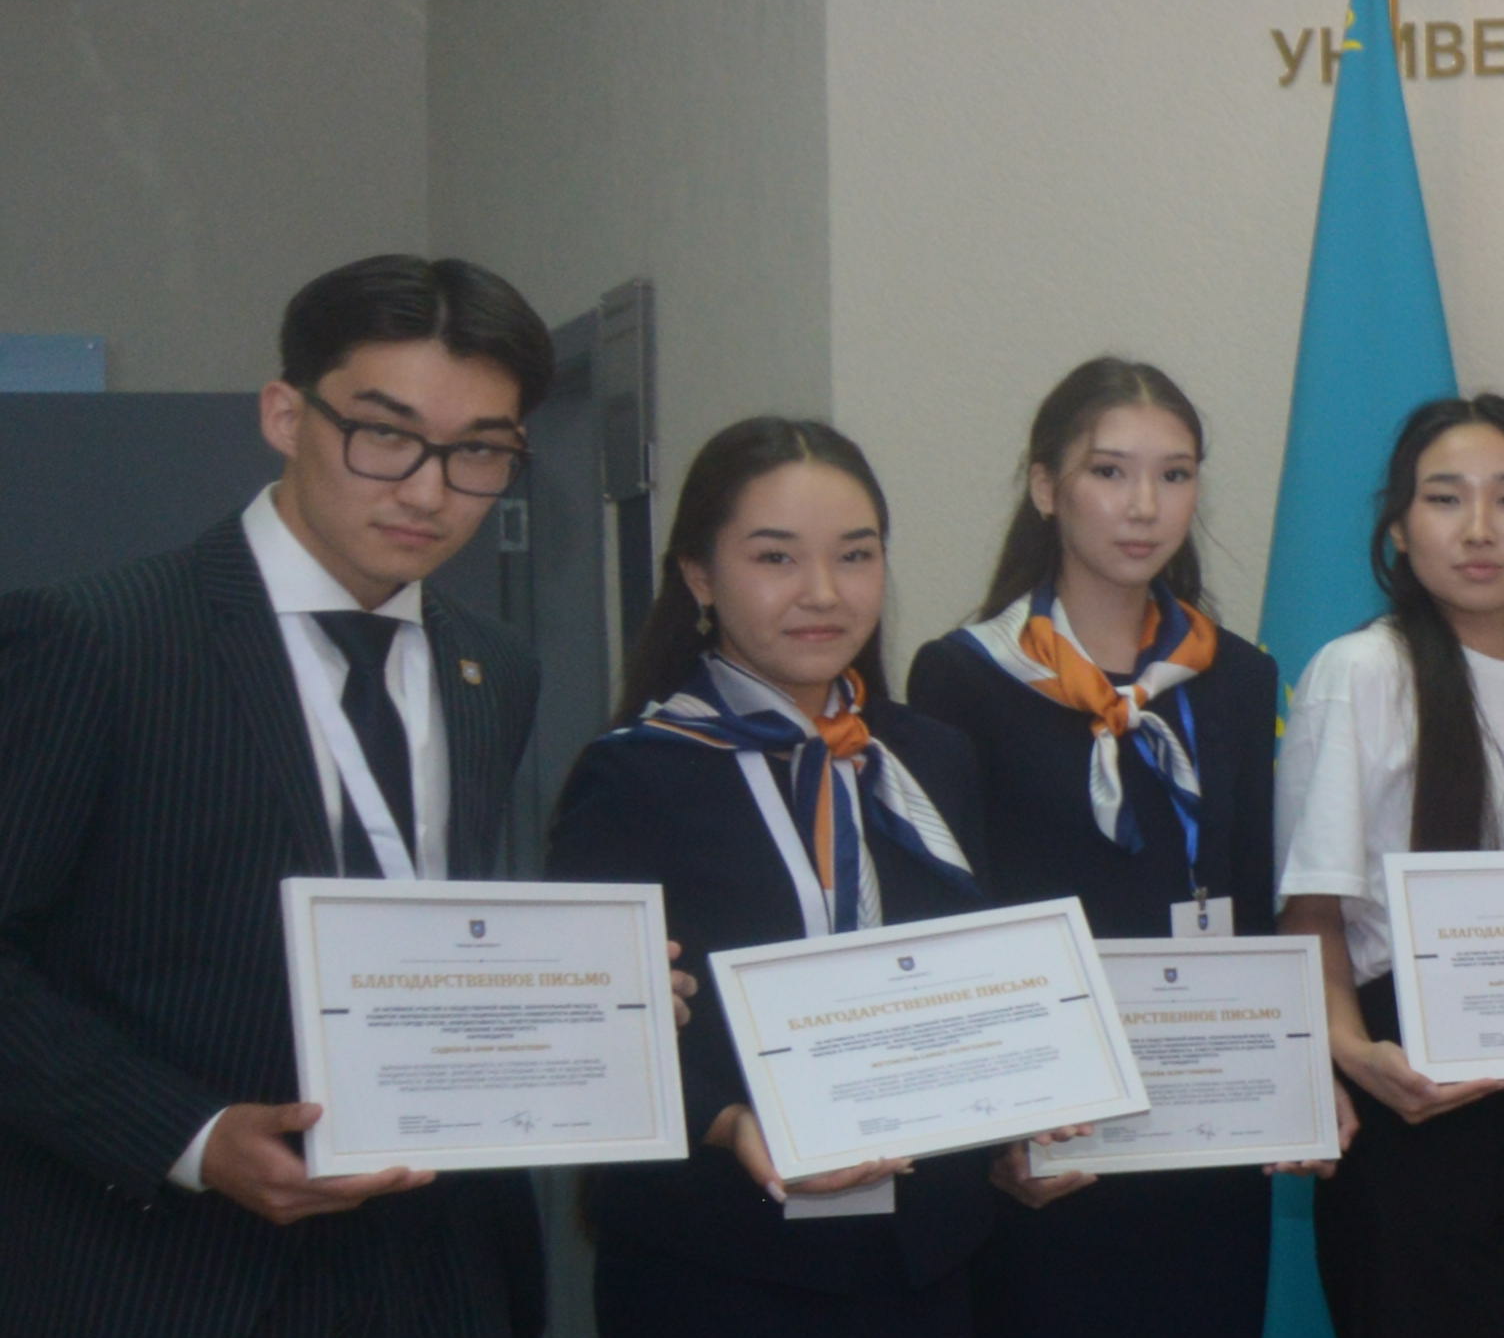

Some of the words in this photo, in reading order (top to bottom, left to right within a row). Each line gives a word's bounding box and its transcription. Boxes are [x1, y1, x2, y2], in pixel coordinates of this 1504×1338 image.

[351, 973, 535, 990] БЛАГОДАРСТВЕННОЕ
[539, 972, 612, 988] ПИСЬМО
[1121, 1010, 1217, 1026] АРСТВЕННОЕ
